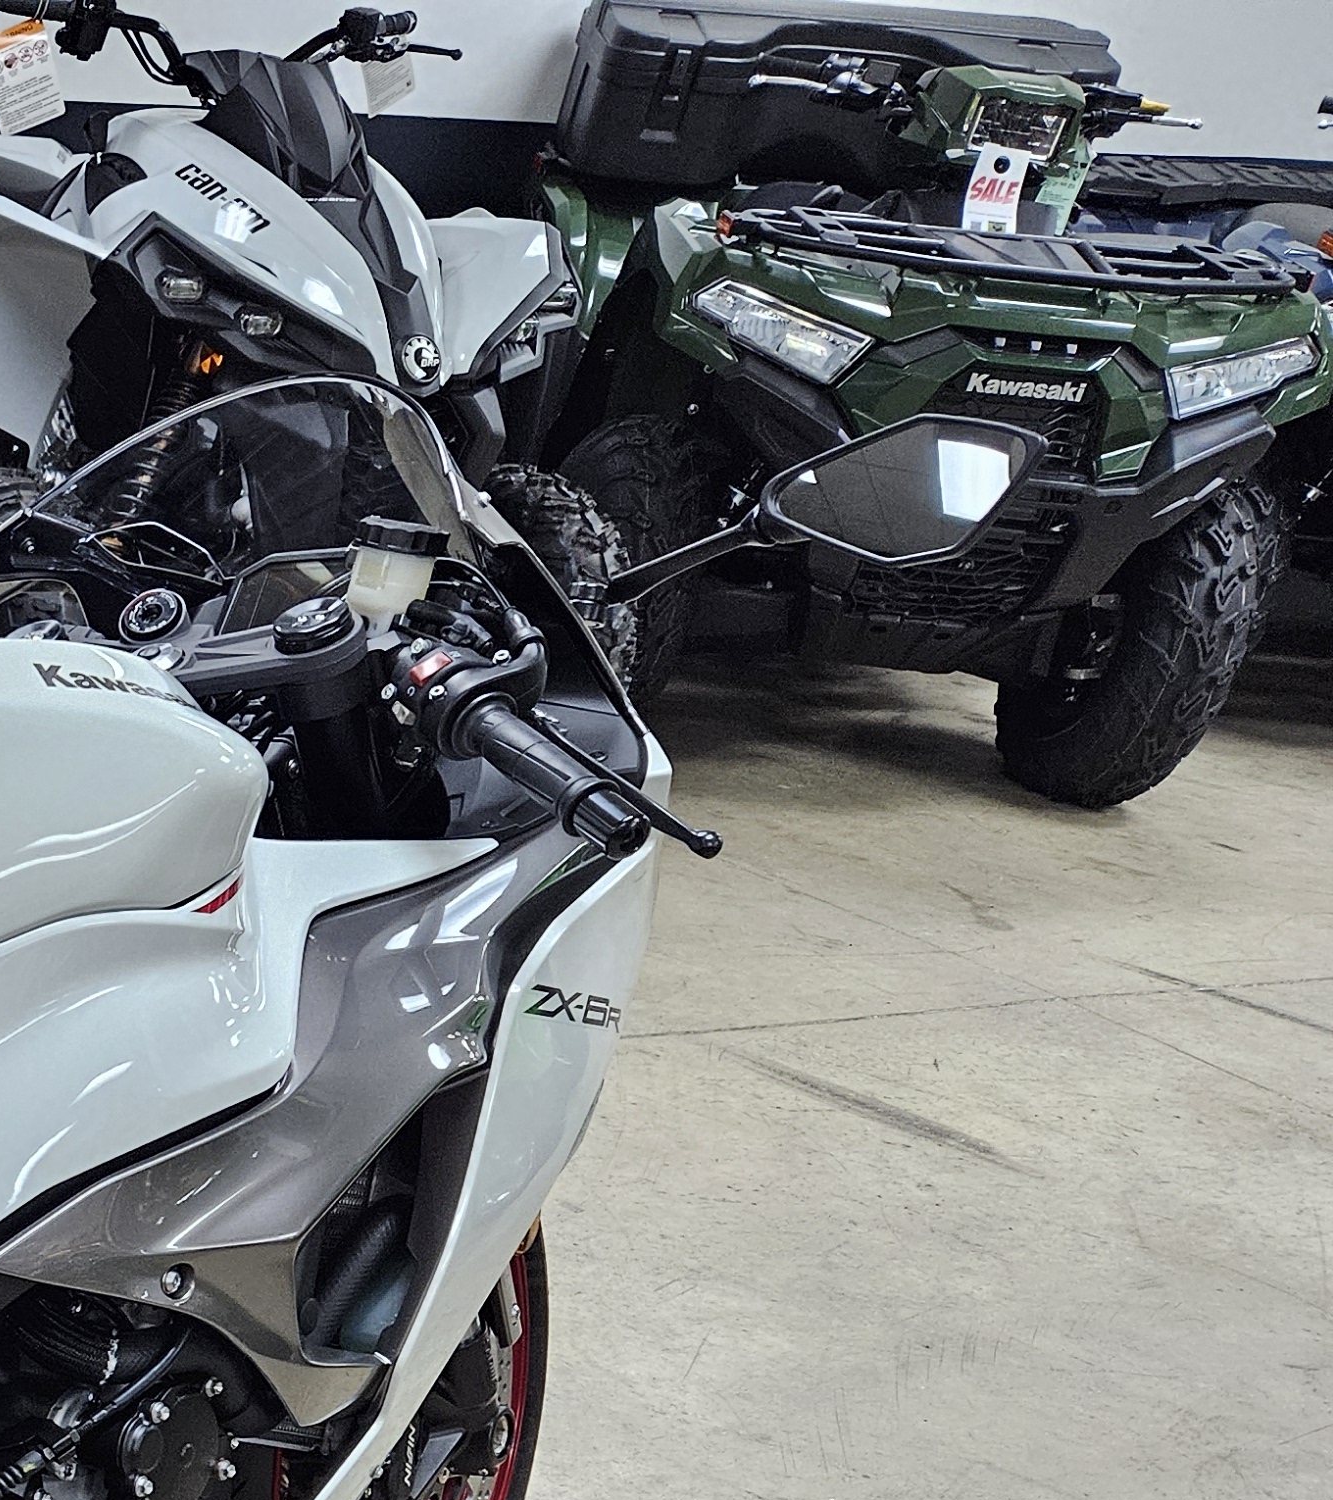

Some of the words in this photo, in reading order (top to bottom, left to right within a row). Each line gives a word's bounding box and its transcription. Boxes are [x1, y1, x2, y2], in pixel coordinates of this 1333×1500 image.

[968, 176, 1020, 205] SALE
[965, 372, 1088, 403] Kawasaki
[33, 662, 199, 710] Kawasa
[522, 983, 622, 1034] ZX-6R
